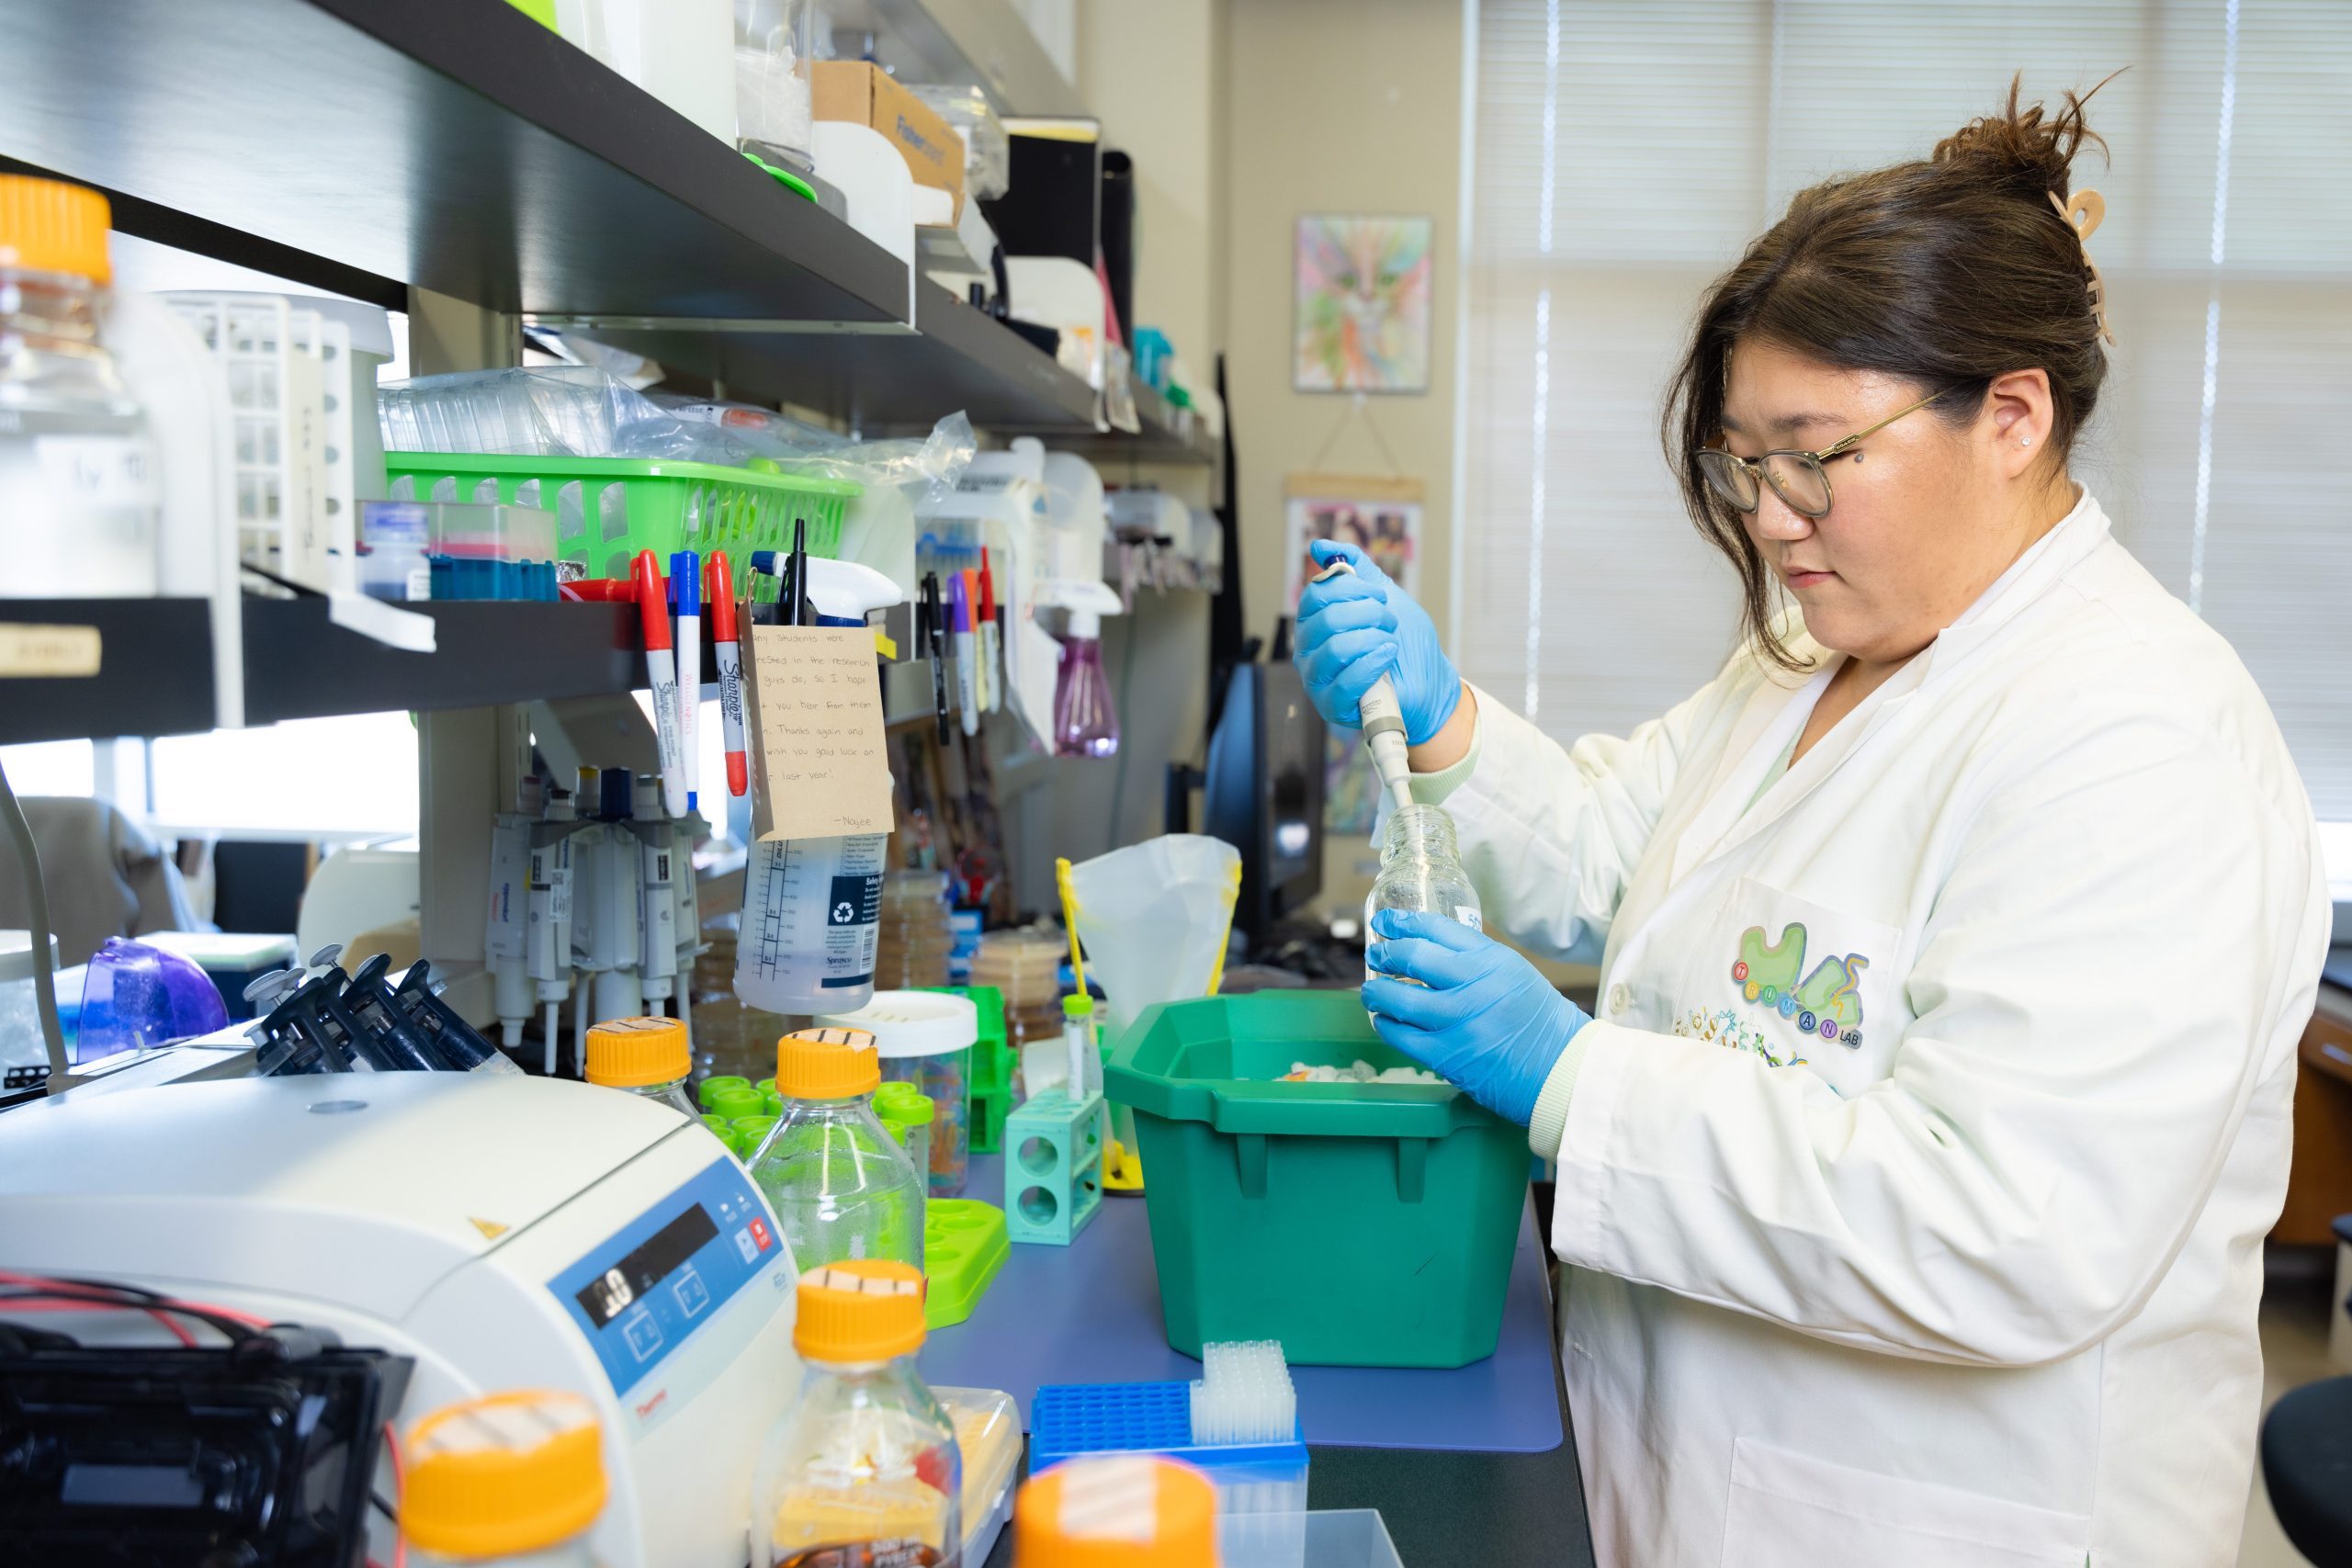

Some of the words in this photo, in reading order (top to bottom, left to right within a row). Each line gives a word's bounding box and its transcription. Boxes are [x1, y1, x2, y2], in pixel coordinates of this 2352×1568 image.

[810, 656, 824, 665] the
[656, 681, 673, 721] Sharpie
[723, 660, 740, 716] Sharpie
[776, 724, 810, 735] Thanks
[817, 729, 842, 739] again
[781, 772, 801, 781] last
[502, 882, 510, 923] eppendorf
[1737, 964, 1835, 1037] TRUMAN
[1839, 1029, 1859, 1046] LAB
